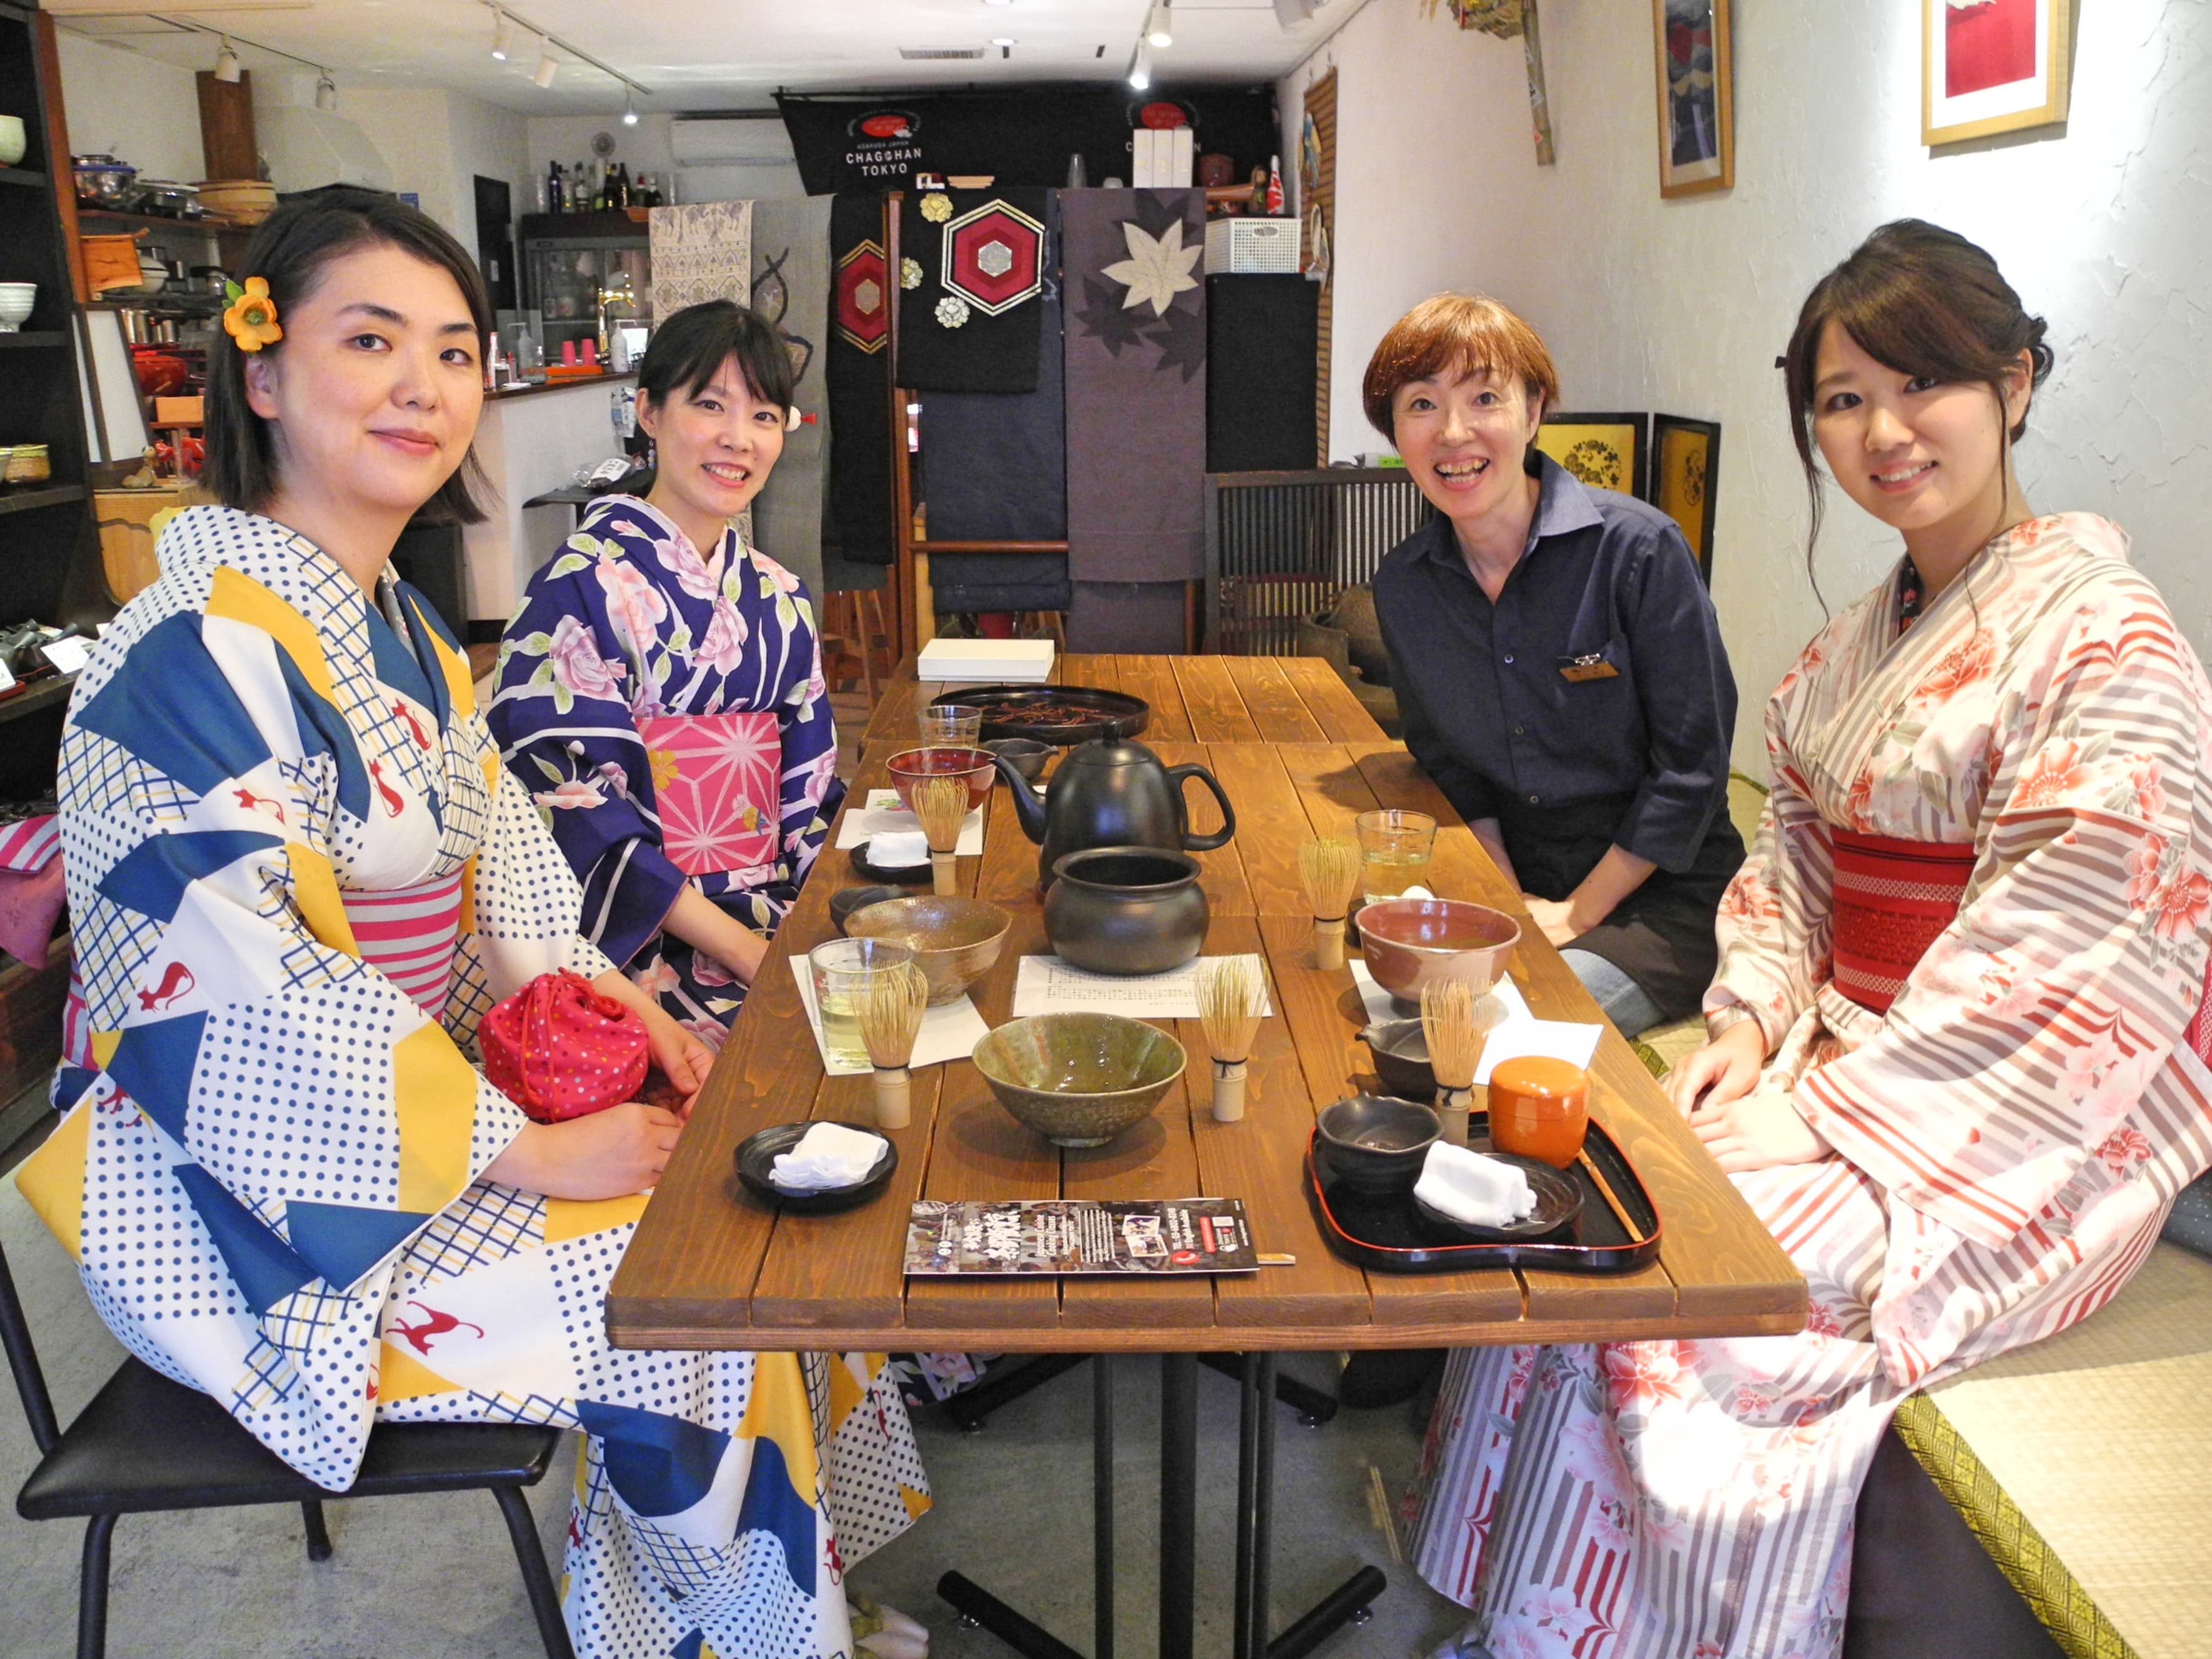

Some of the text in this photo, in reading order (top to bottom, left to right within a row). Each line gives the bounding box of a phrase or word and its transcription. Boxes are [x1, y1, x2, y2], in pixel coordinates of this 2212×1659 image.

[846, 149, 922, 164] CHAGOHAN
[862, 163, 907, 176] TOKYO
[1045, 1216, 1059, 1255] Cooking Classes
